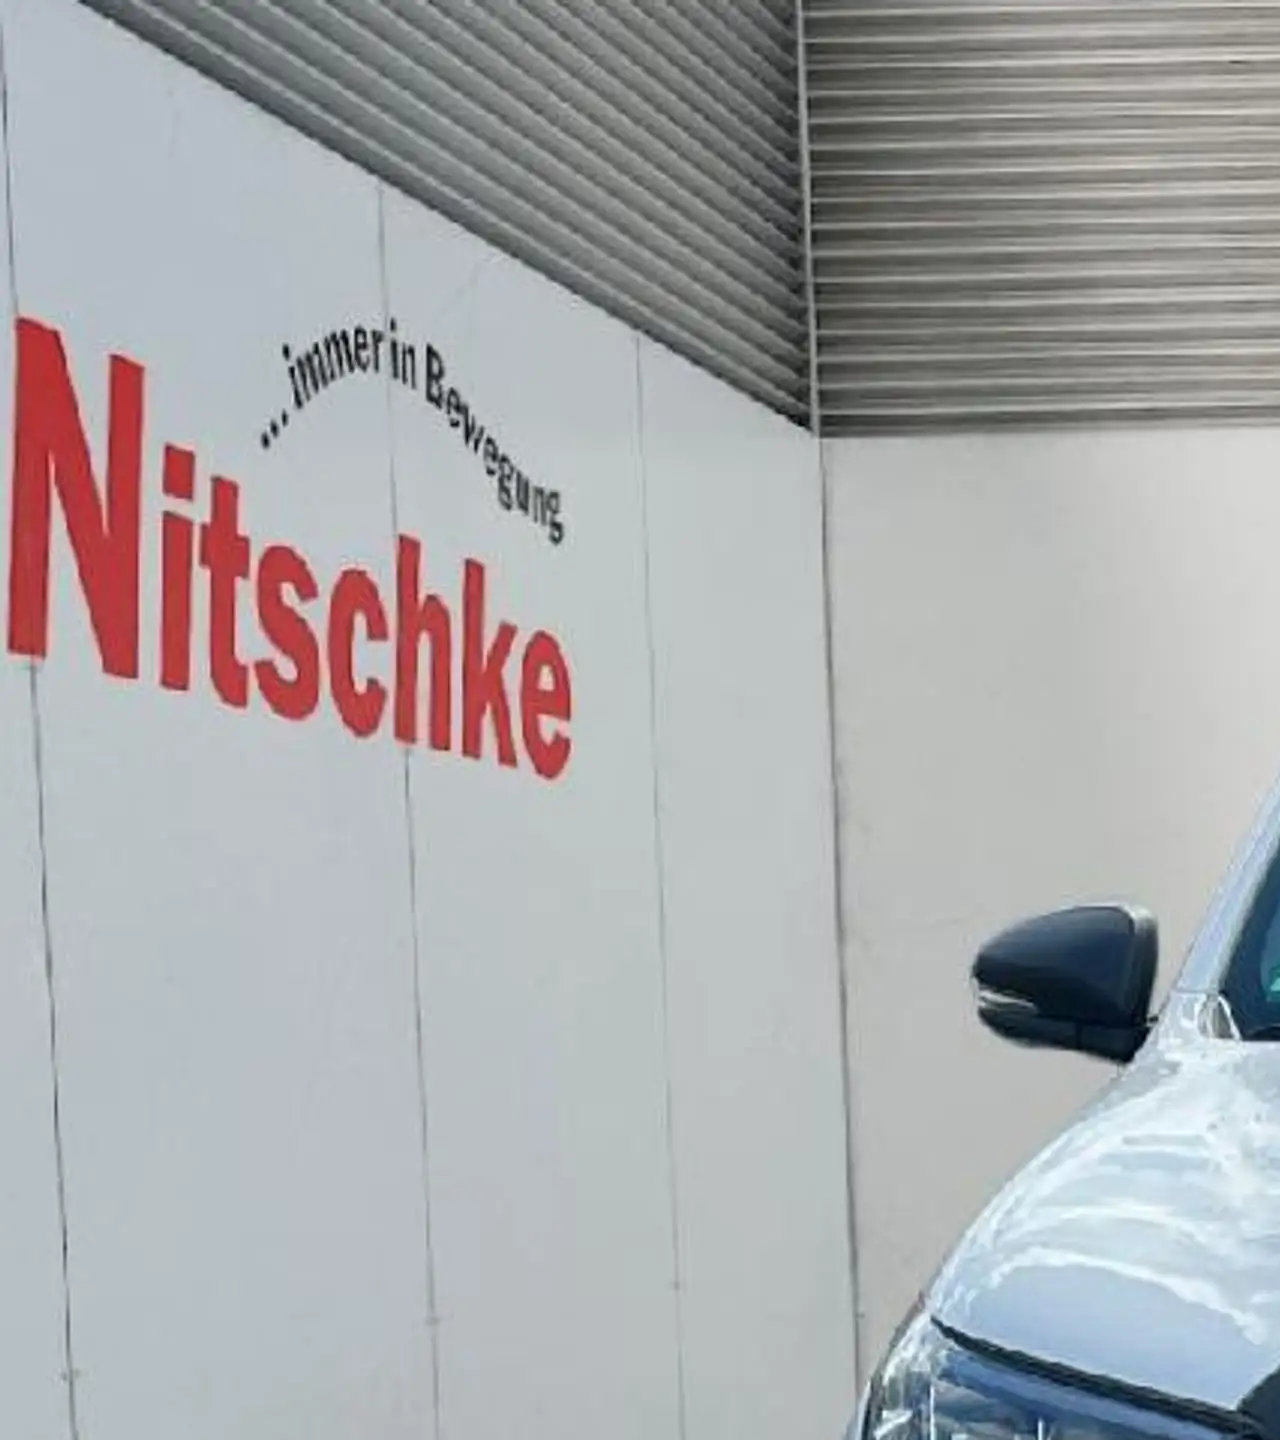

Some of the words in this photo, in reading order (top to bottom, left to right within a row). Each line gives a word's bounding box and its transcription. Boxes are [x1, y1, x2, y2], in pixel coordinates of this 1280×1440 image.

[8, 316, 572, 779] Nitschke
[388, 318, 417, 389] in
[424, 342, 565, 545] Bewegung
